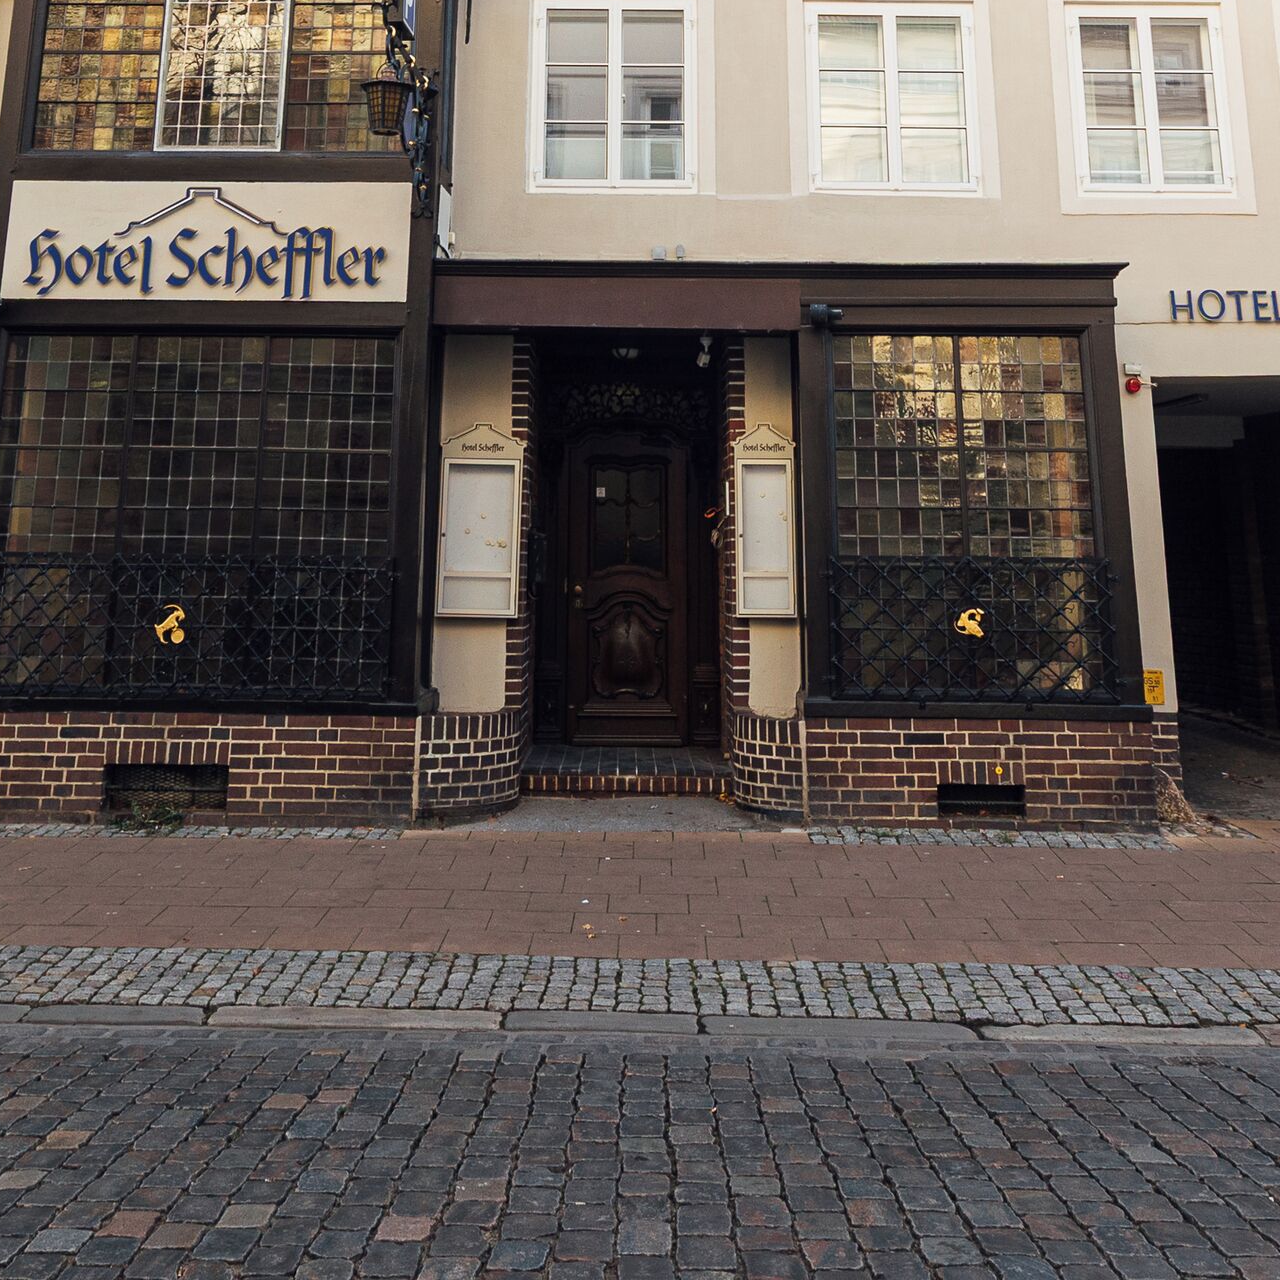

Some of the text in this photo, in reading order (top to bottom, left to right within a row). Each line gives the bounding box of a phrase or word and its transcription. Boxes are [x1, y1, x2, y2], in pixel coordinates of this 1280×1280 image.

[23, 225, 387, 299] Hotel Scheffler
[461, 443, 505, 453] Hotel Scheffler
[742, 443, 786, 453] Hotel Scheffler
